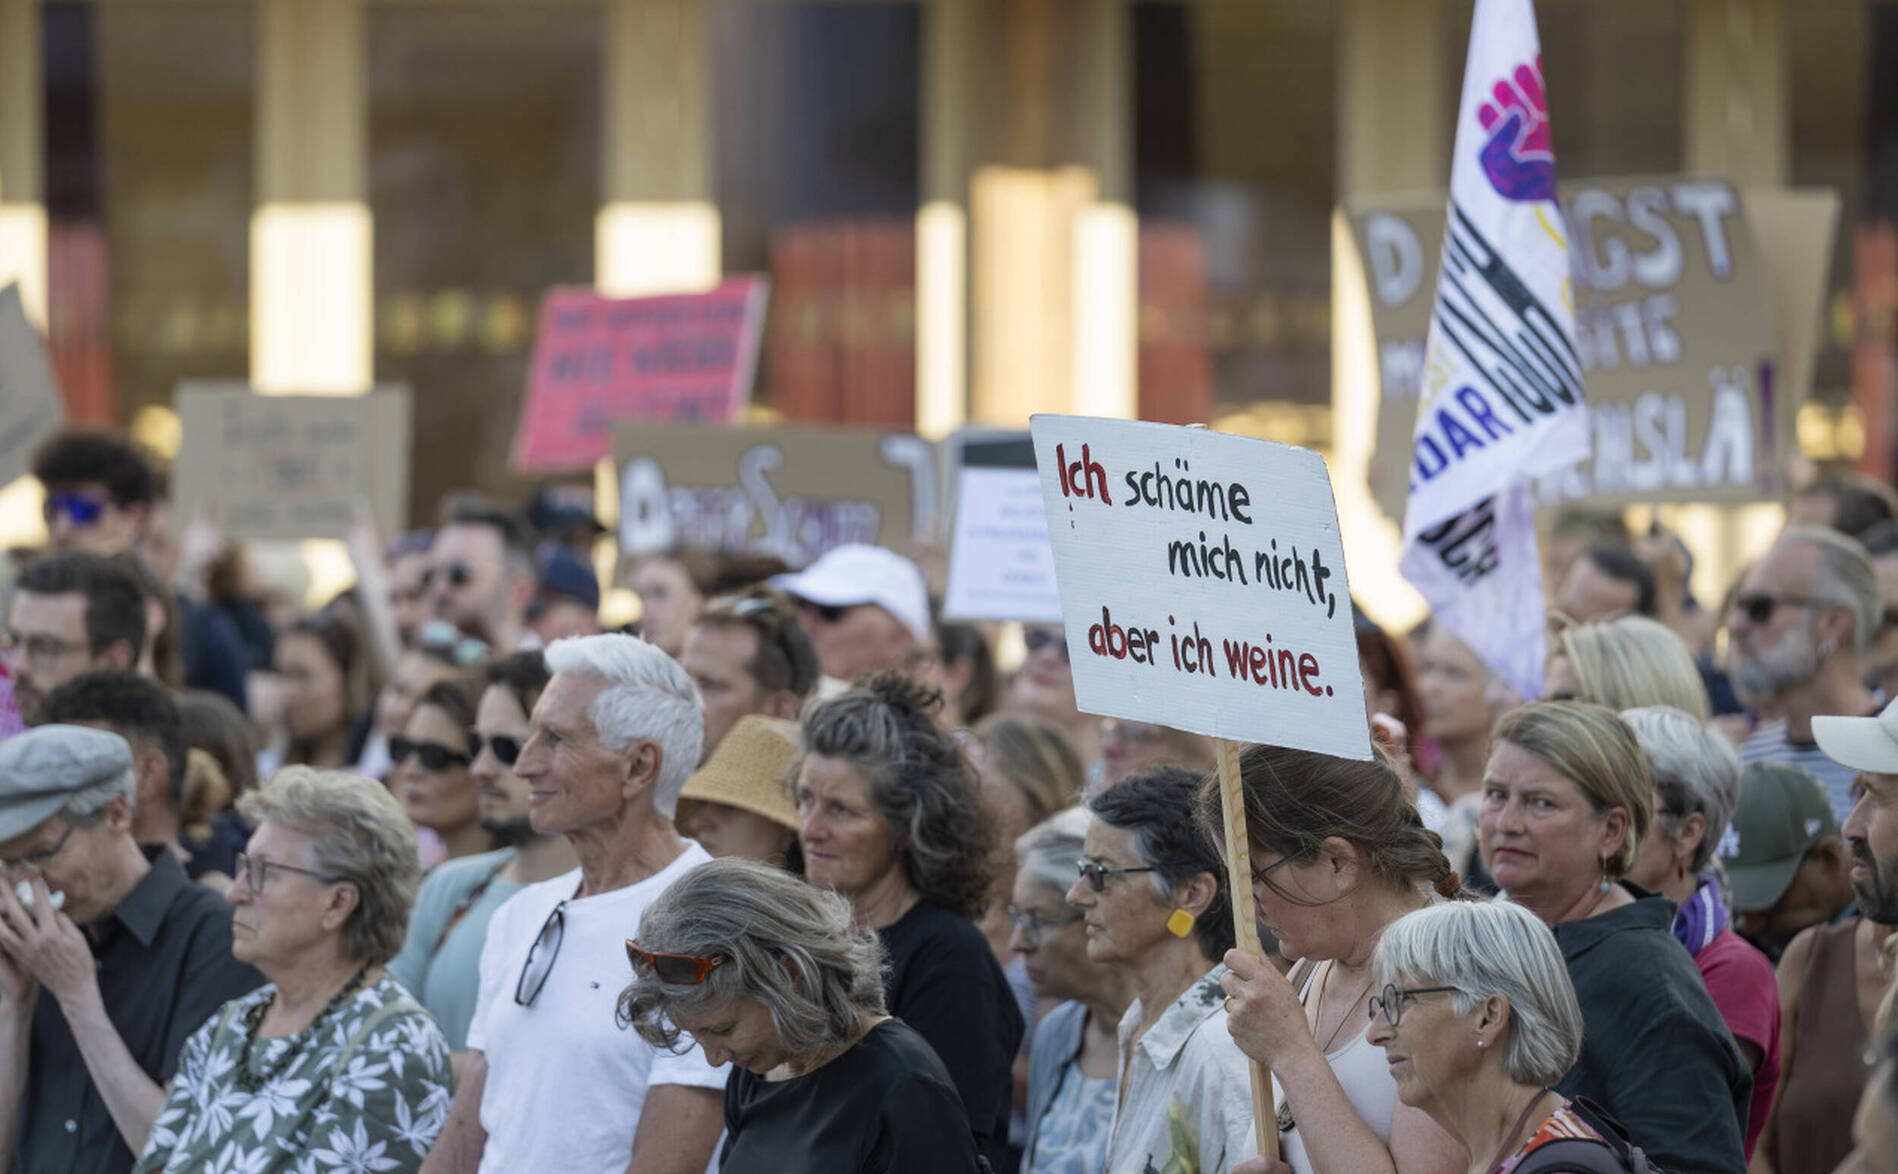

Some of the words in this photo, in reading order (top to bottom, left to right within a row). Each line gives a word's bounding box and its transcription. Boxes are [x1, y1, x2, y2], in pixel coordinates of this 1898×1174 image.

[1056, 443, 1112, 506] Ich
[1125, 458, 1252, 524] schäme
[1168, 531, 1248, 585] mich
[1255, 538, 1336, 619] nicht,
[1088, 605, 1159, 665] aber
[1168, 615, 1216, 677] ich
[1223, 633, 1334, 697] weine.
